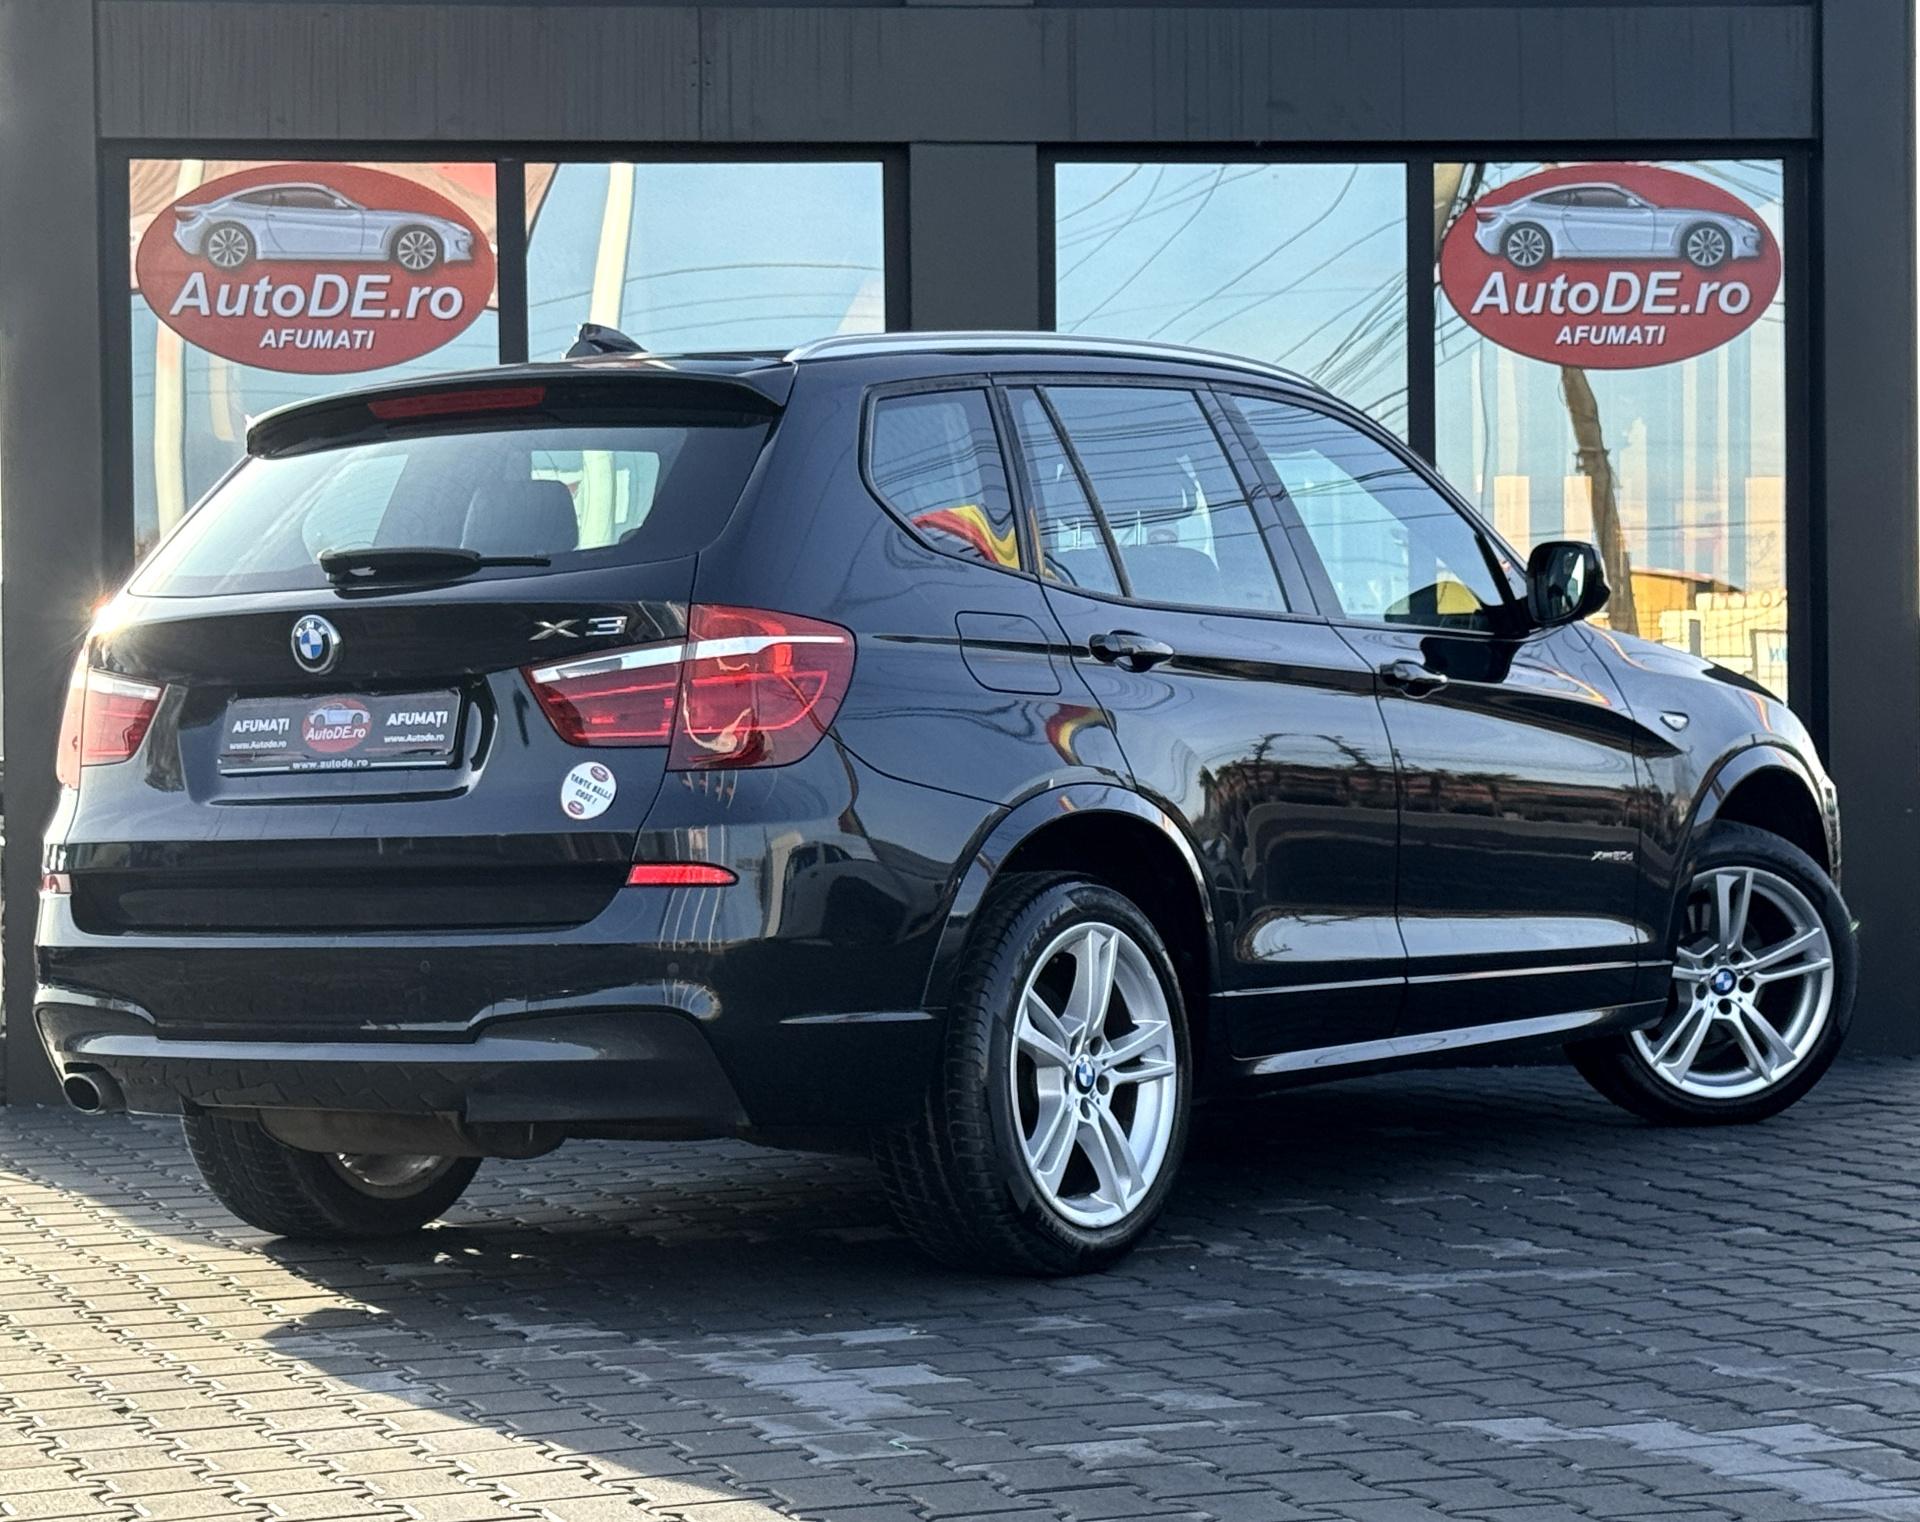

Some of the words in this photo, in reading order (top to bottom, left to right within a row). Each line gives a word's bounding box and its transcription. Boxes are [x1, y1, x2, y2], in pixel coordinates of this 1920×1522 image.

[169, 271, 464, 319] AutoDE.ro
[1471, 271, 1751, 315] AutoDE.ro
[259, 328, 375, 349] AFUMATI
[1555, 325, 1666, 345] AFUMATI
[305, 726, 366, 741] AutoDE.ro
[293, 758, 368, 769] www.autode.ro
